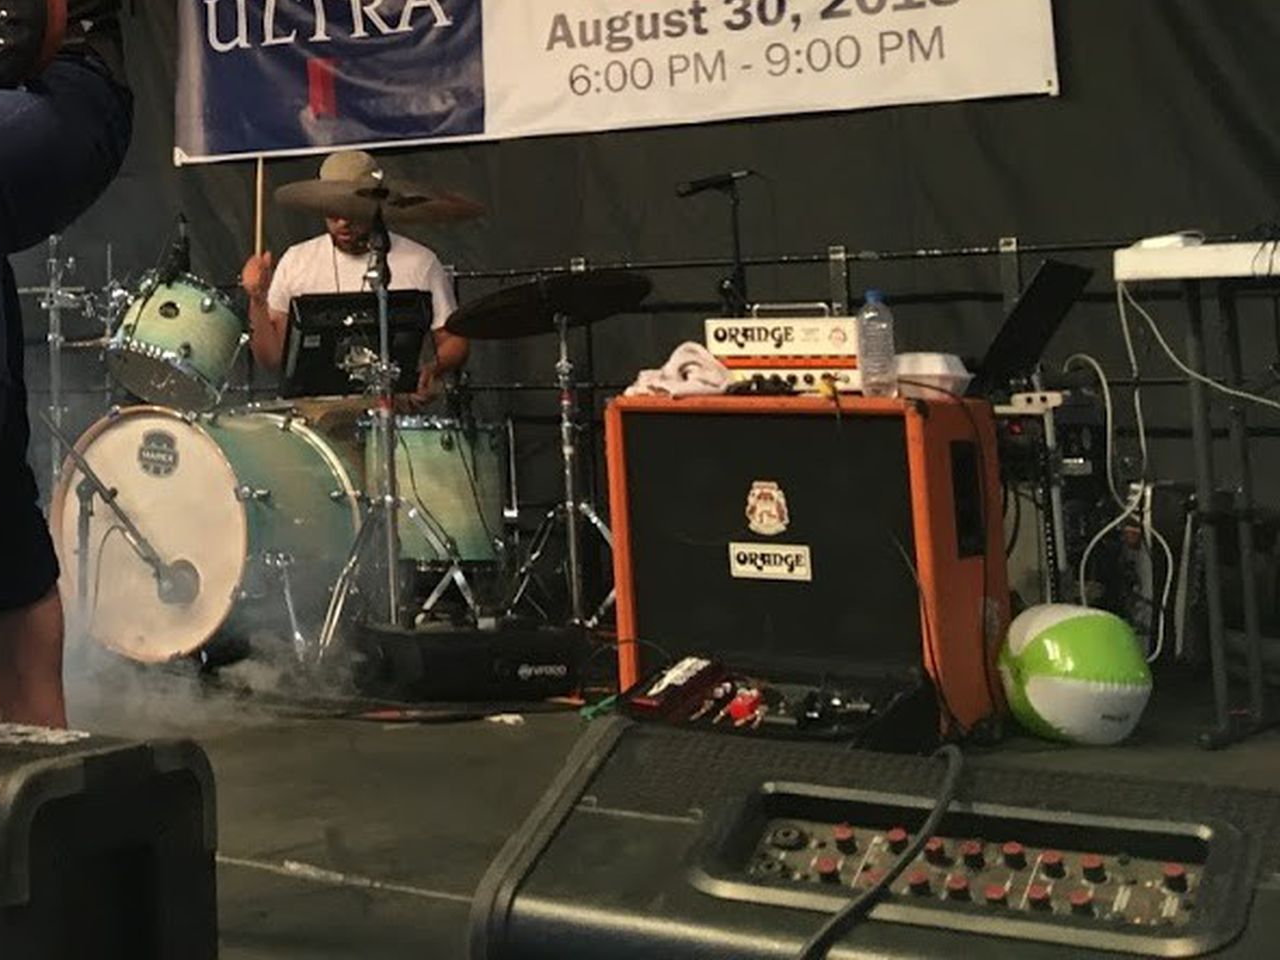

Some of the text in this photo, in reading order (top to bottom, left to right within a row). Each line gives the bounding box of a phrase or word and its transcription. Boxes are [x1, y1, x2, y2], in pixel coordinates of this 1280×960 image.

[545, 0, 708, 53] August
[568, 57, 654, 96] 6:00
[668, 49, 726, 87] PM
[765, 34, 861, 77] 9:00
[878, 25, 945, 65] PM
[713, 326, 794, 349] ORANGE
[736, 551, 803, 573] ORANGE
